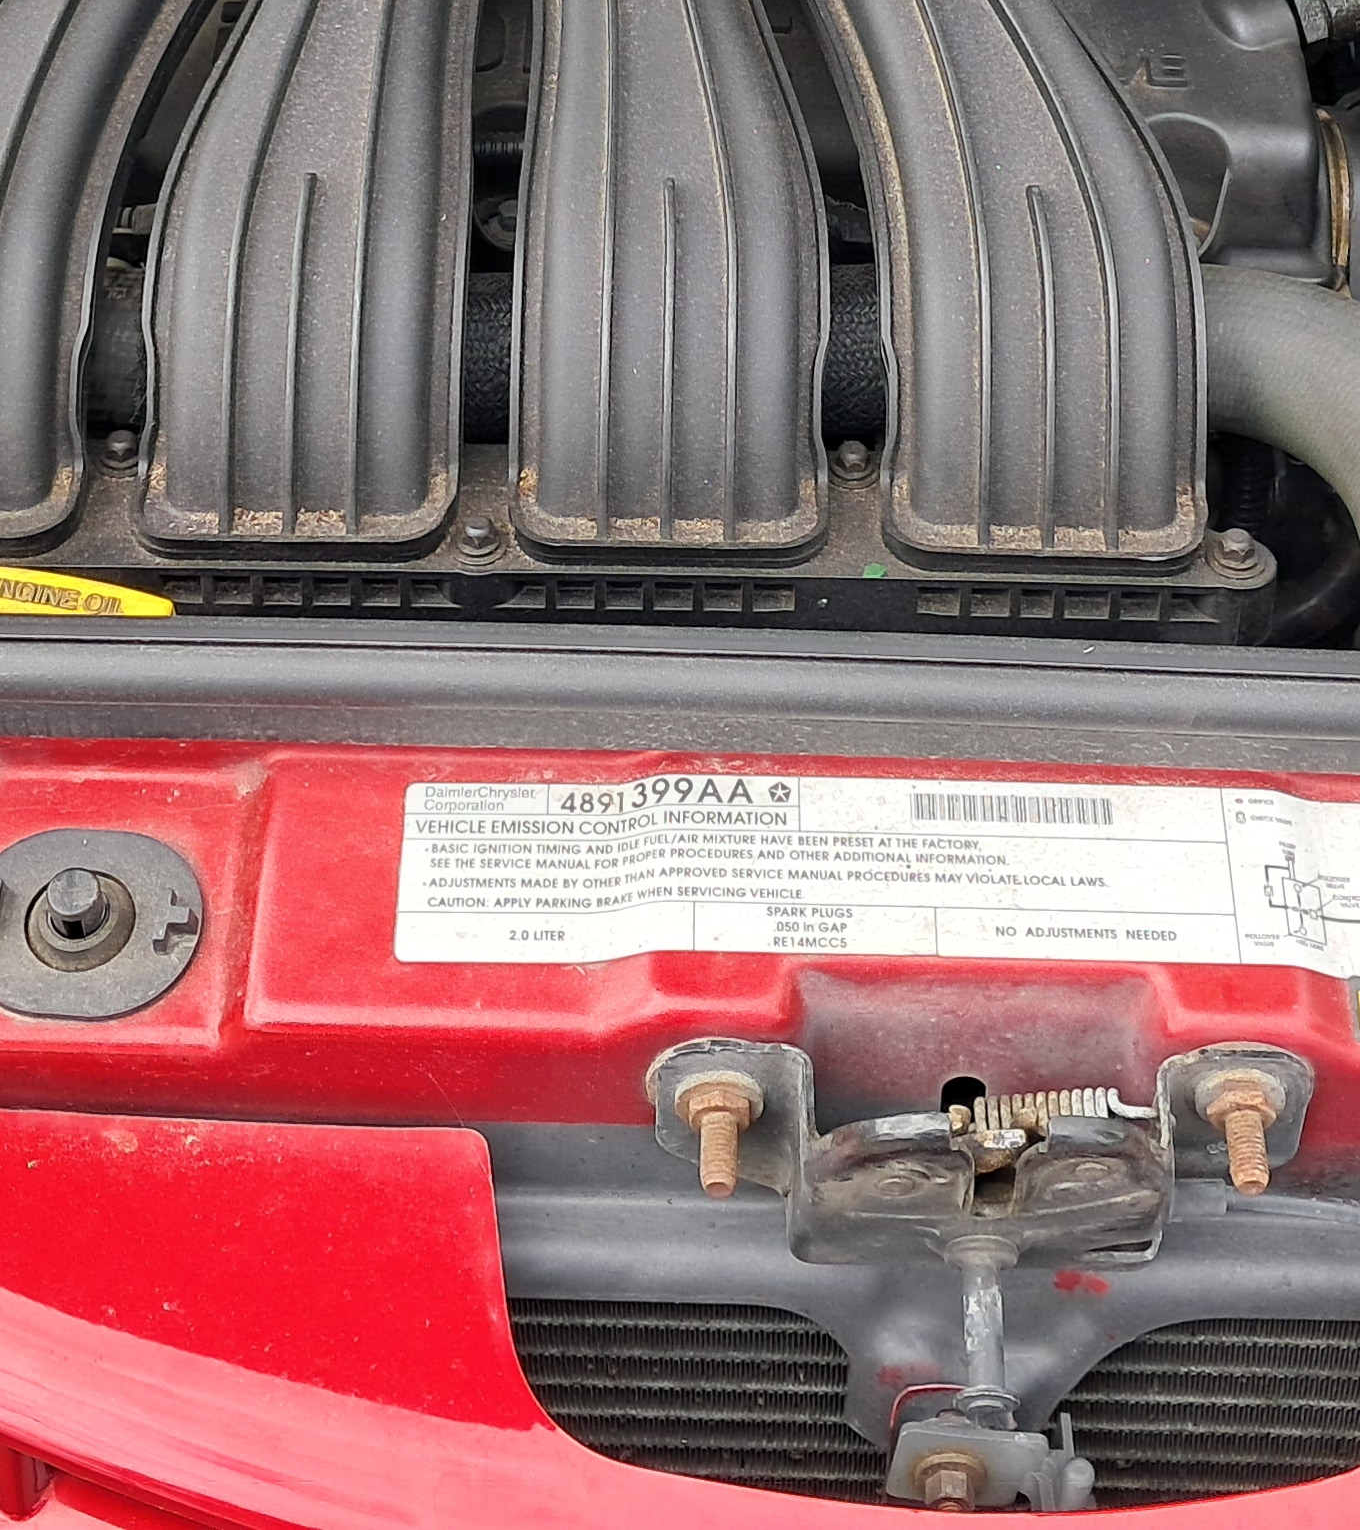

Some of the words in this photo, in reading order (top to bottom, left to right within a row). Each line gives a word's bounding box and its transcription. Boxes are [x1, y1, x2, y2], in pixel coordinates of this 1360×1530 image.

[82, 592, 124, 615] OIL
[425, 786, 536, 800] DaimlerChrysler
[560, 776, 754, 814] 4891399AA
[424, 800, 504, 813] Corporation
[416, 819, 486, 835] VEHICLE
[491, 820, 574, 835] EMISSION
[578, 813, 658, 836] CONTROL
[663, 810, 787, 826] INFORMATION
[431, 843, 470, 854] BASIC
[473, 844, 532, 855] IGNITION
[537, 844, 582, 855] TIMING
[587, 844, 613, 855] AND
[617, 838, 640, 853] IDLE
[643, 833, 699, 845] FUEL/AIR
[703, 834, 756, 845] MIXTURE
[760, 834, 794, 846] HAVE
[798, 836, 828, 847] BEEN
[833, 836, 874, 848] PRESET
[878, 837, 894, 849] AT
[896, 838, 918, 849] THE
[430, 858, 451, 869] SEE
[455, 858, 476, 869] THE
[480, 858, 531, 869] SERVICE
[536, 859, 590, 870] MANUAL
[594, 859, 619, 870] FOR
[622, 849, 666, 867] PROPER
[670, 848, 753, 860] PROCEDURES
[757, 849, 785, 860] AND
[789, 850, 829, 861] OTHER
[833, 851, 912, 863] ADDITIONAL
[915, 853, 1010, 866] INFORMATION.
[428, 877, 516, 889] ADJUSTMENTS
[520, 878, 559, 889] MADE
[563, 878, 579, 889] BY
[583, 876, 622, 889] OTHER
[625, 869, 655, 885] THAN
[659, 867, 728, 878] APPROVED
[731, 868, 783, 879] SERVICE
[788, 869, 842, 881] MANUAL
[847, 871, 931, 884] PROCEDURES
[934, 872, 963, 884] MAY
[1024, 875, 1067, 886] LOCAL
[427, 897, 490, 908] CAUTION:
[494, 897, 531, 908] APPLY
[536, 898, 592, 909] PARKING
[596, 892, 634, 908] BRAKE
[637, 886, 673, 899] WHEN
[677, 886, 747, 898] SERVICING
[766, 906, 807, 918] SPARK
[811, 907, 853, 919] PLUGS
[509, 930, 530, 941] 2.0
[533, 930, 566, 942] LITER
[818, 923, 848, 933] GAP
[995, 926, 1017, 937] NO
[1025, 927, 1117, 940] ADJUSTMENTS
[1126, 929, 1177, 941] NEEDED
[773, 936, 848, 948] RE14MCC5
